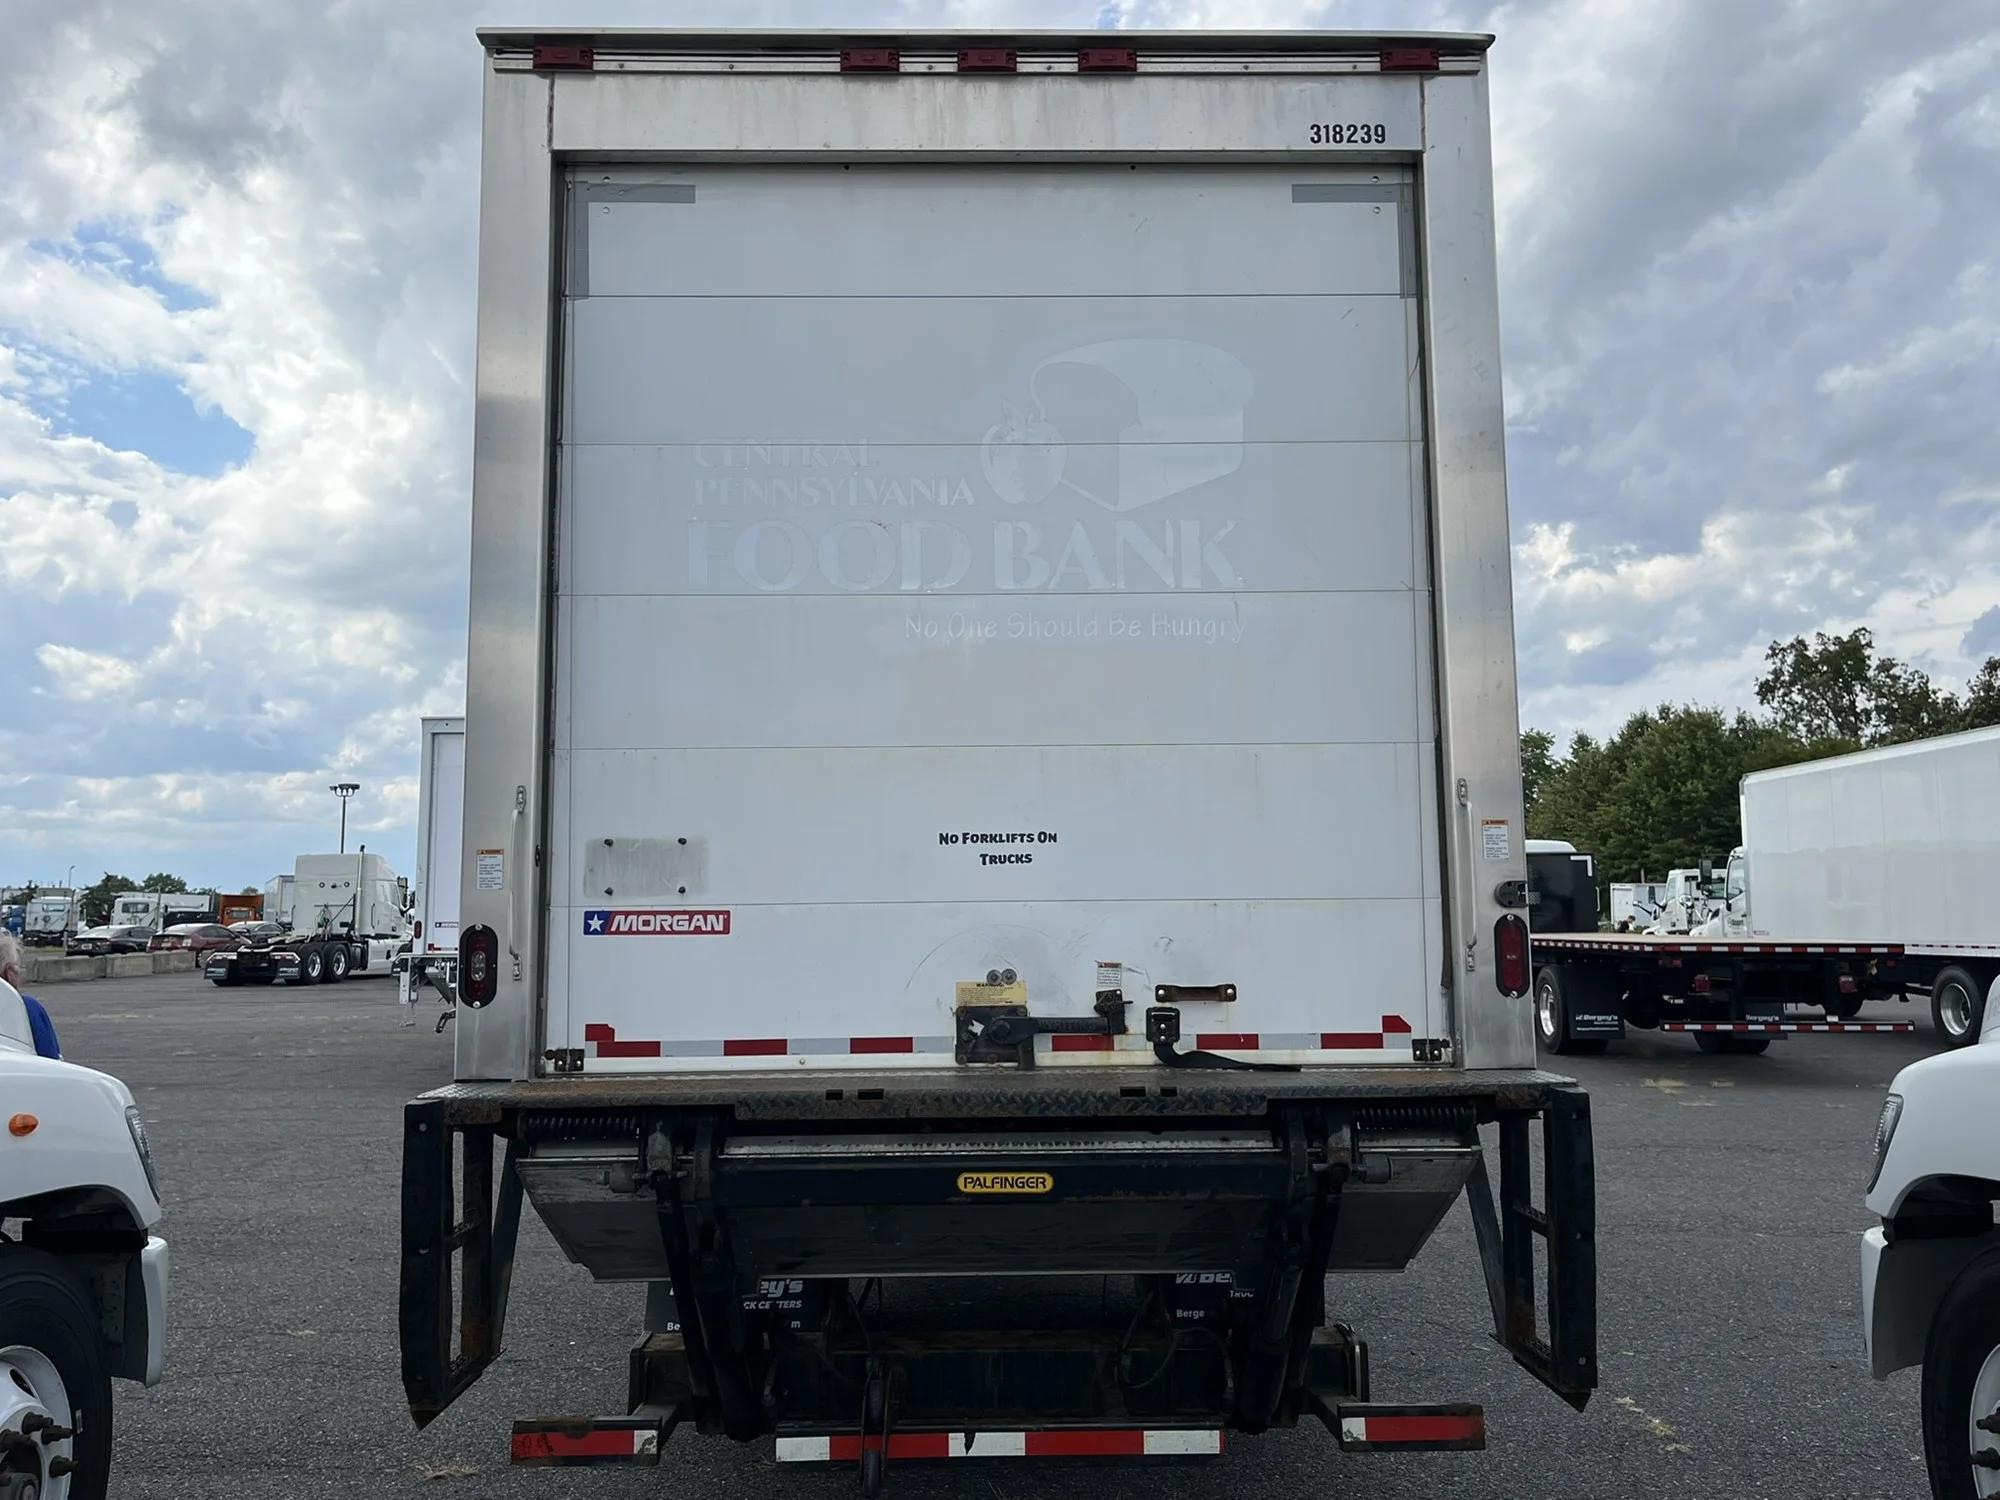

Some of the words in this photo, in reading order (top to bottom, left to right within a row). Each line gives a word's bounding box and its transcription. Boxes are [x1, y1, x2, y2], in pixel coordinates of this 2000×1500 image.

[1309, 123, 1387, 144] 318239
[692, 438, 874, 468] CENTRAL
[693, 476, 976, 507] PENNSYLVANIA
[687, 518, 974, 592] FOOD
[991, 518, 1246, 591] BANK
[904, 613, 938, 639] No
[948, 611, 998, 638] One
[1007, 610, 1099, 638] Should
[1108, 611, 1142, 638] Be
[1152, 611, 1246, 644] Hungry
[611, 914, 726, 932] MORGAN
[963, 1176, 1048, 1190] PALFINGER
[759, 1300, 802, 1309] CETERS
